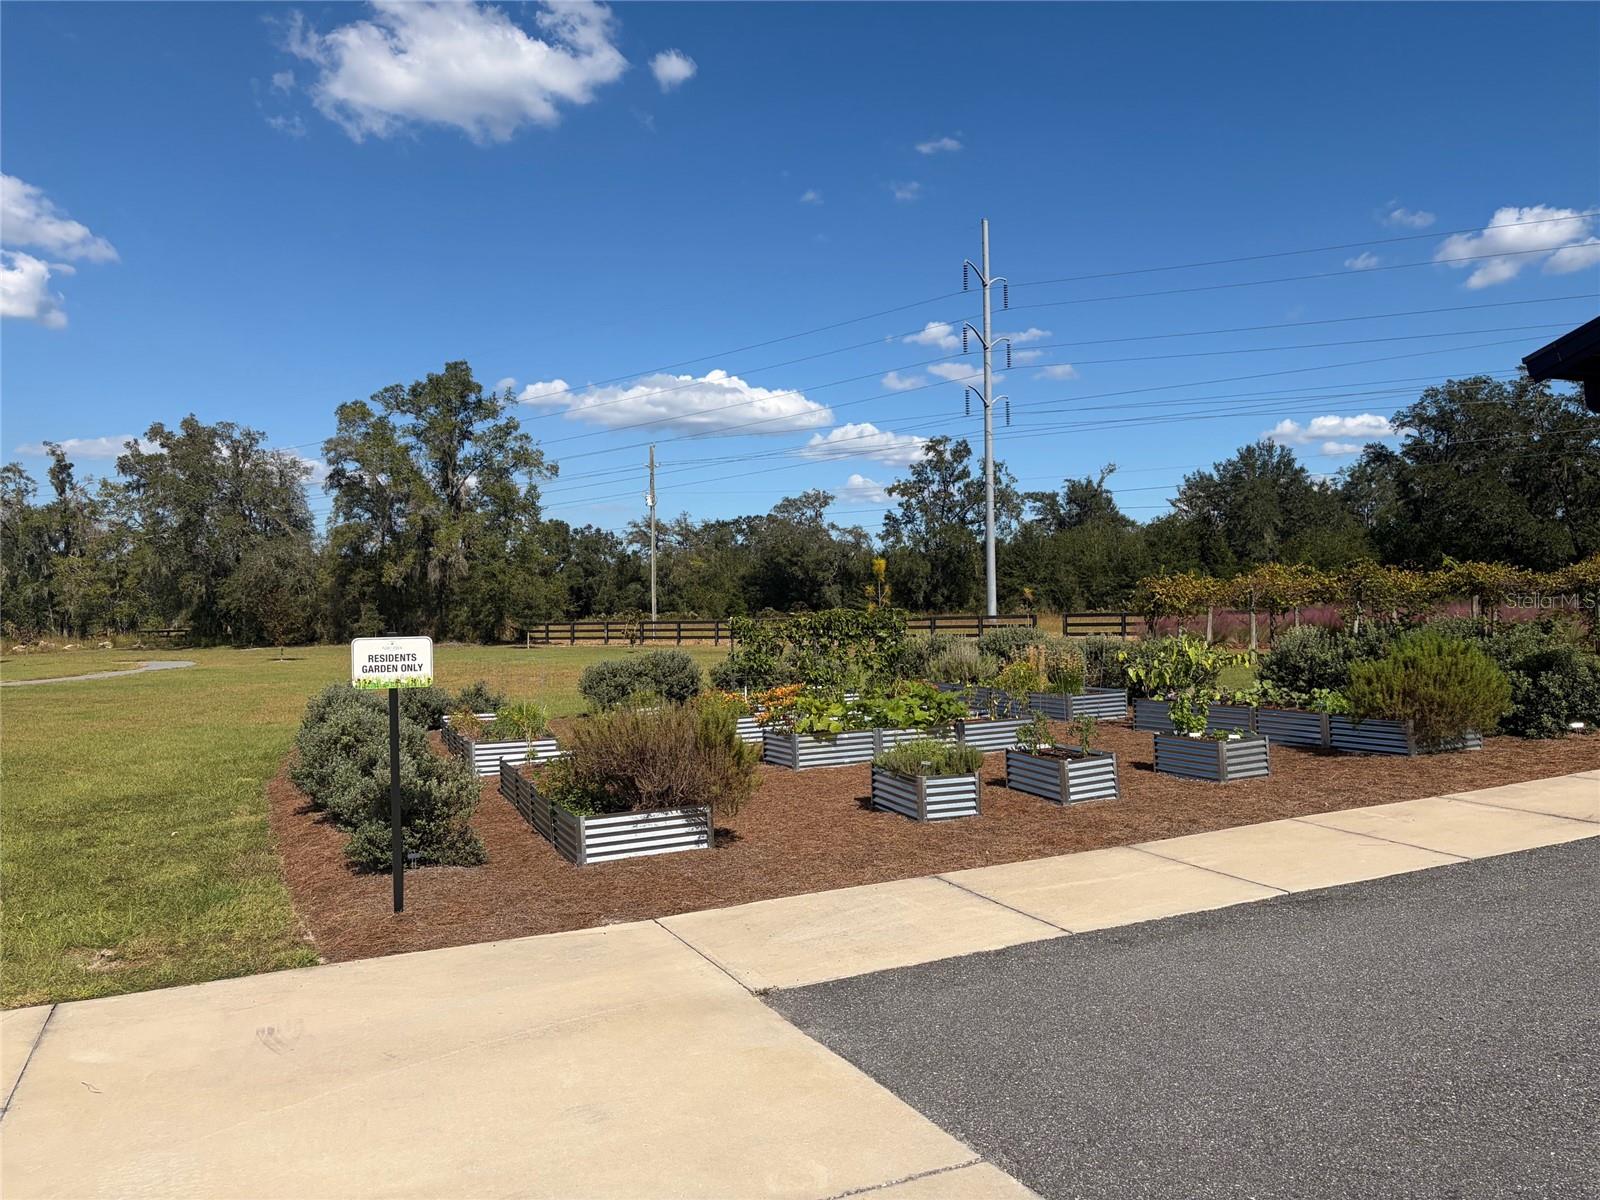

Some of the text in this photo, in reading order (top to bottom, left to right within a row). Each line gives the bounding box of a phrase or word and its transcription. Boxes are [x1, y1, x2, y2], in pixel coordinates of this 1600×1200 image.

[368, 653, 417, 663] RESIDENTS
[362, 663, 423, 673] GARDEN ONLY
